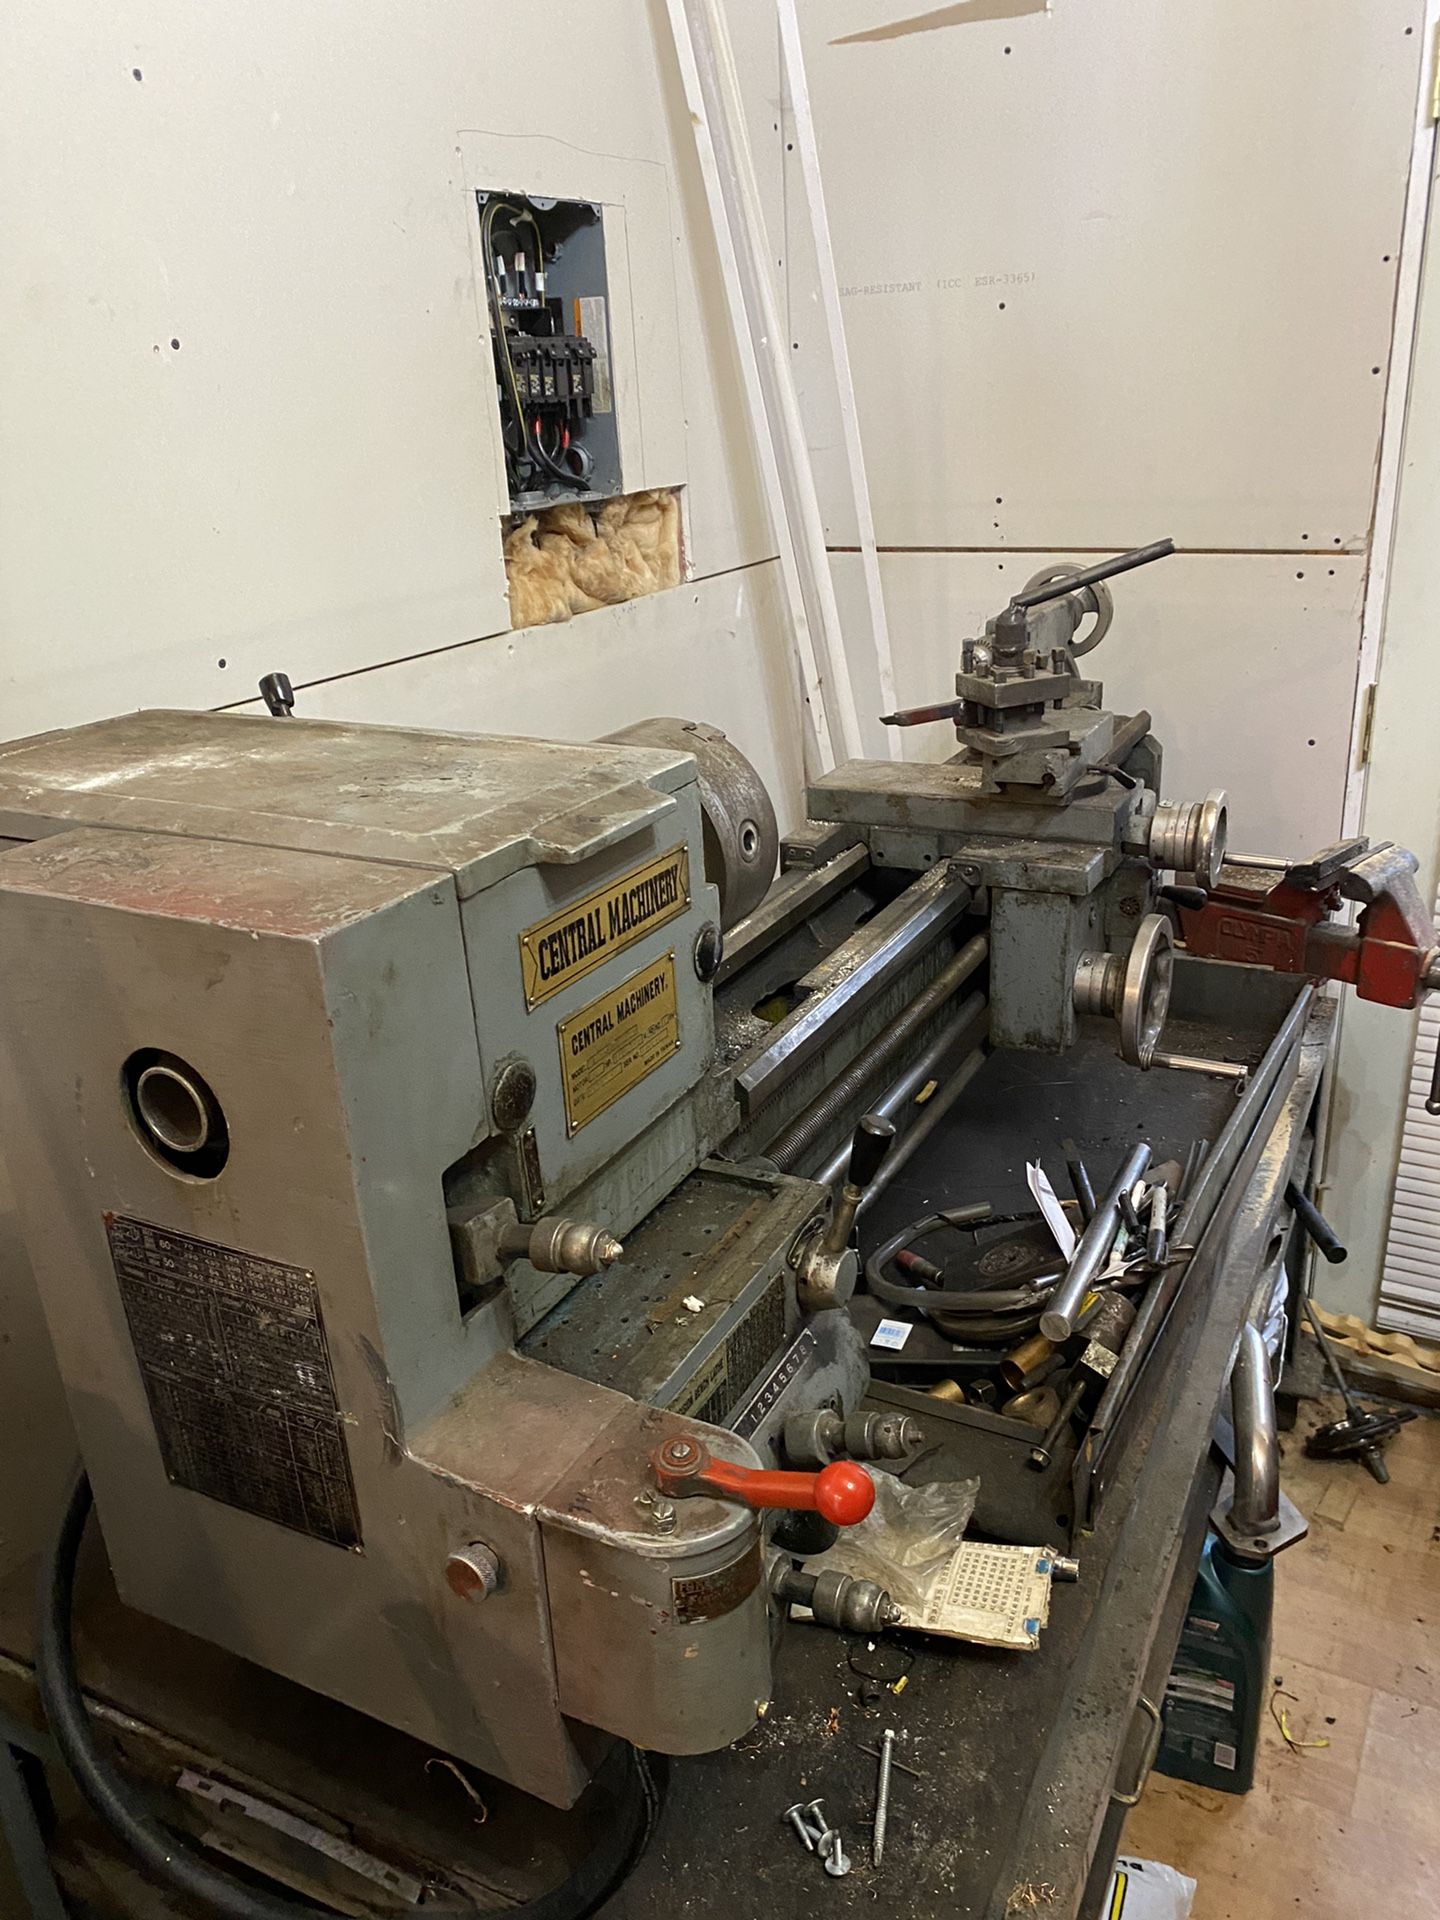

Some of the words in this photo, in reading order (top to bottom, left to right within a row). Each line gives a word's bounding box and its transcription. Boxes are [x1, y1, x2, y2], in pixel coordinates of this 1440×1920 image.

[937, 278, 961, 290] (ICC
[538, 908, 606, 981] CENTRAL
[607, 863, 678, 941] MACHINERY
[571, 1011, 614, 1056] CENTRAL
[159, 1239, 171, 1250] 60
[162, 1257, 175, 1268] 50
[765, 1392, 773, 1403] 3
[778, 1373, 787, 1383] 5
[786, 1363, 794, 1373] 6
